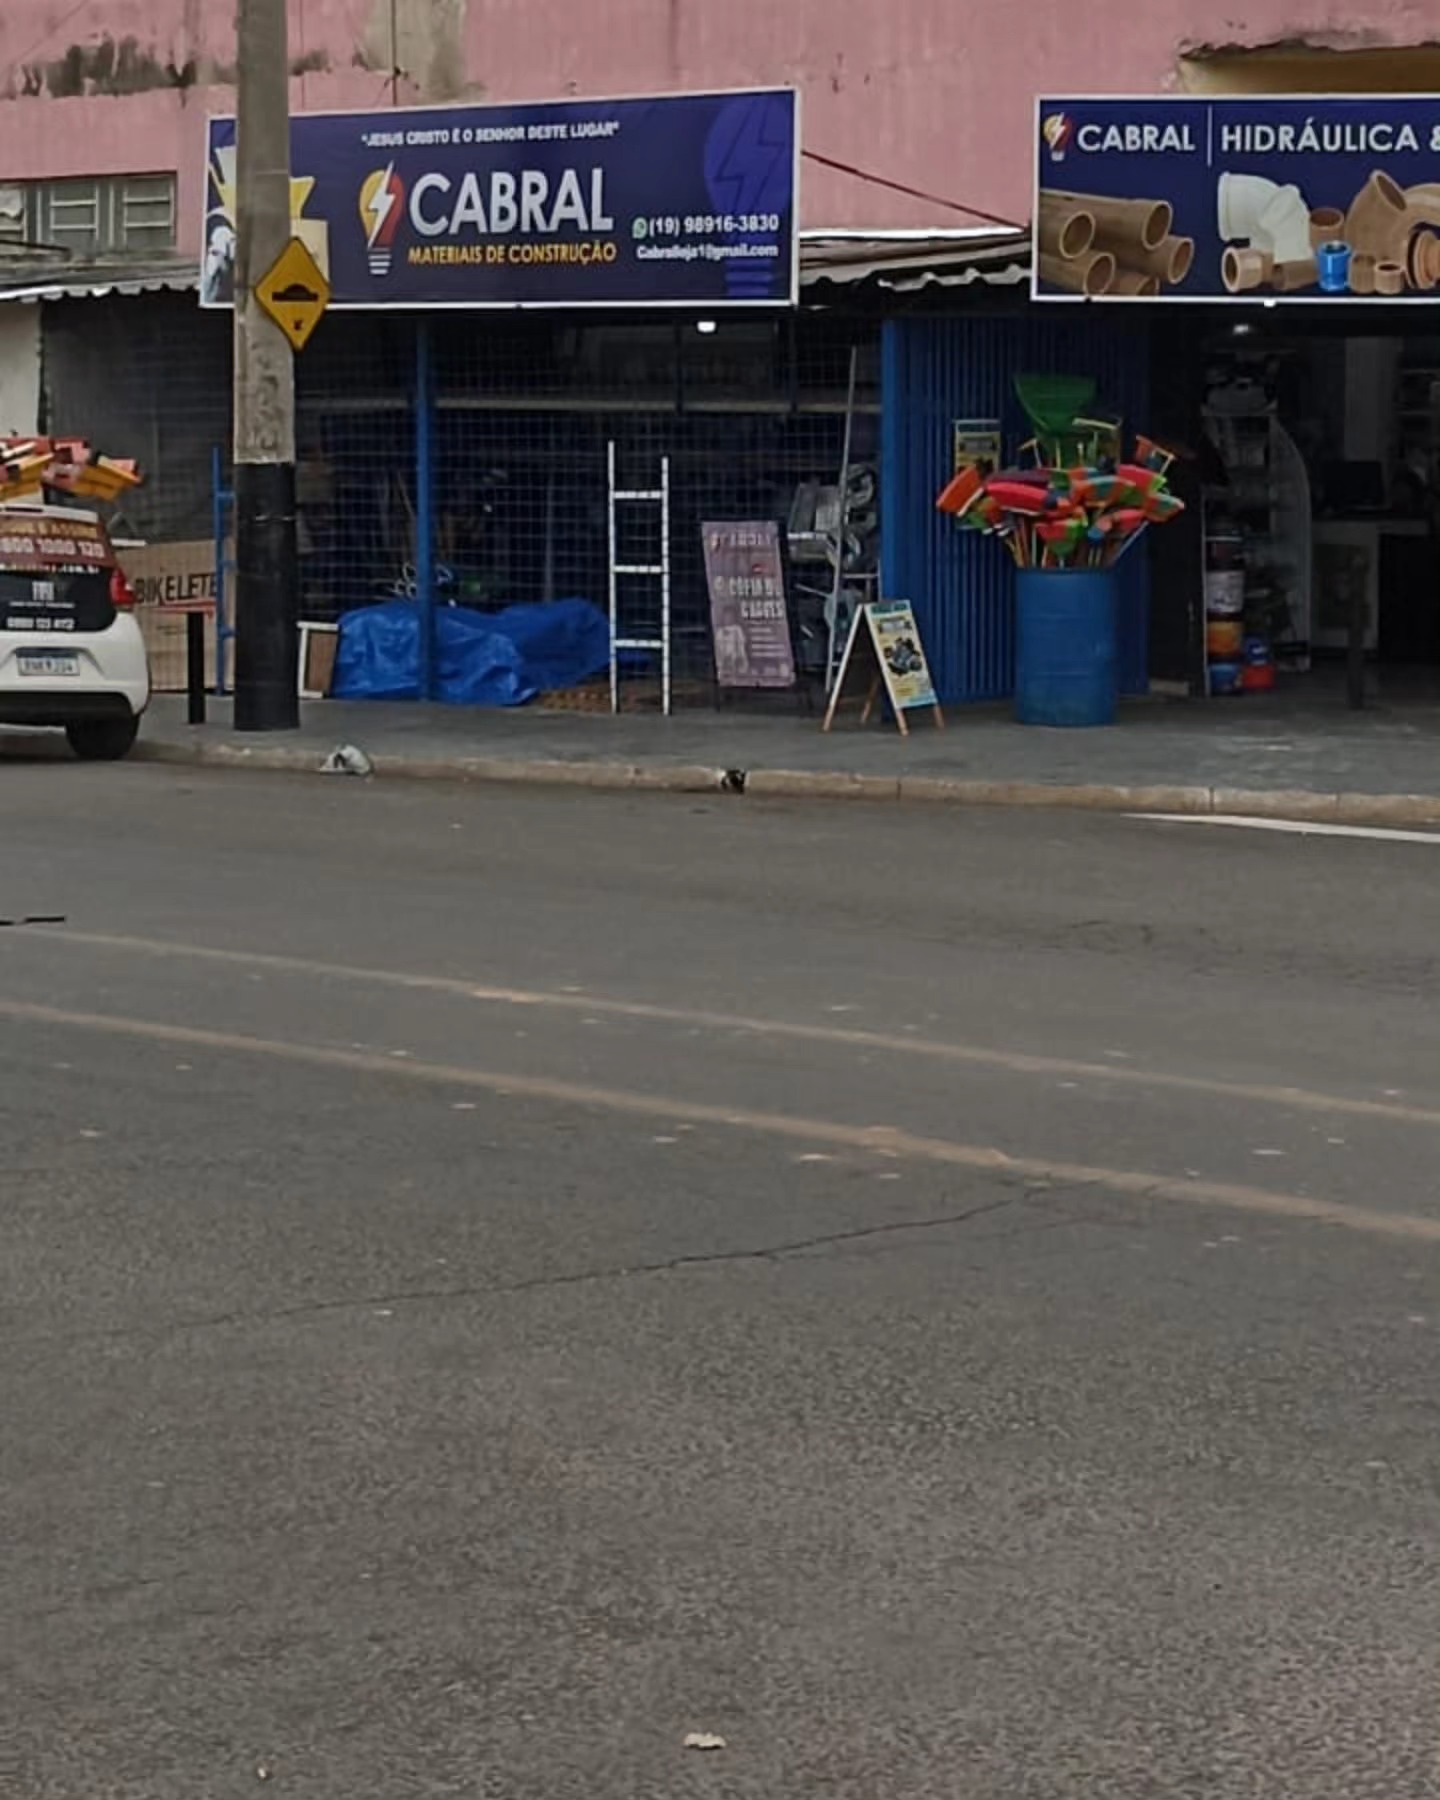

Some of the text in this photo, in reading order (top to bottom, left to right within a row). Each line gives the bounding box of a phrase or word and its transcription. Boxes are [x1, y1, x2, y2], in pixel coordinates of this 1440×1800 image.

[406, 129, 449, 145] CRISTO
[463, 129, 472, 142] O
[475, 126, 525, 142] SENHOR
[527, 123, 567, 140] DESTE
[1077, 123, 1196, 152] CABRAL
[1220, 117, 1419, 152] HIDRÁULICA
[409, 167, 614, 237] CABRAL
[650, 214, 779, 237] (19) 98916-3830
[408, 240, 617, 266] MATERIAIS DE CONSTRUÇÃO
